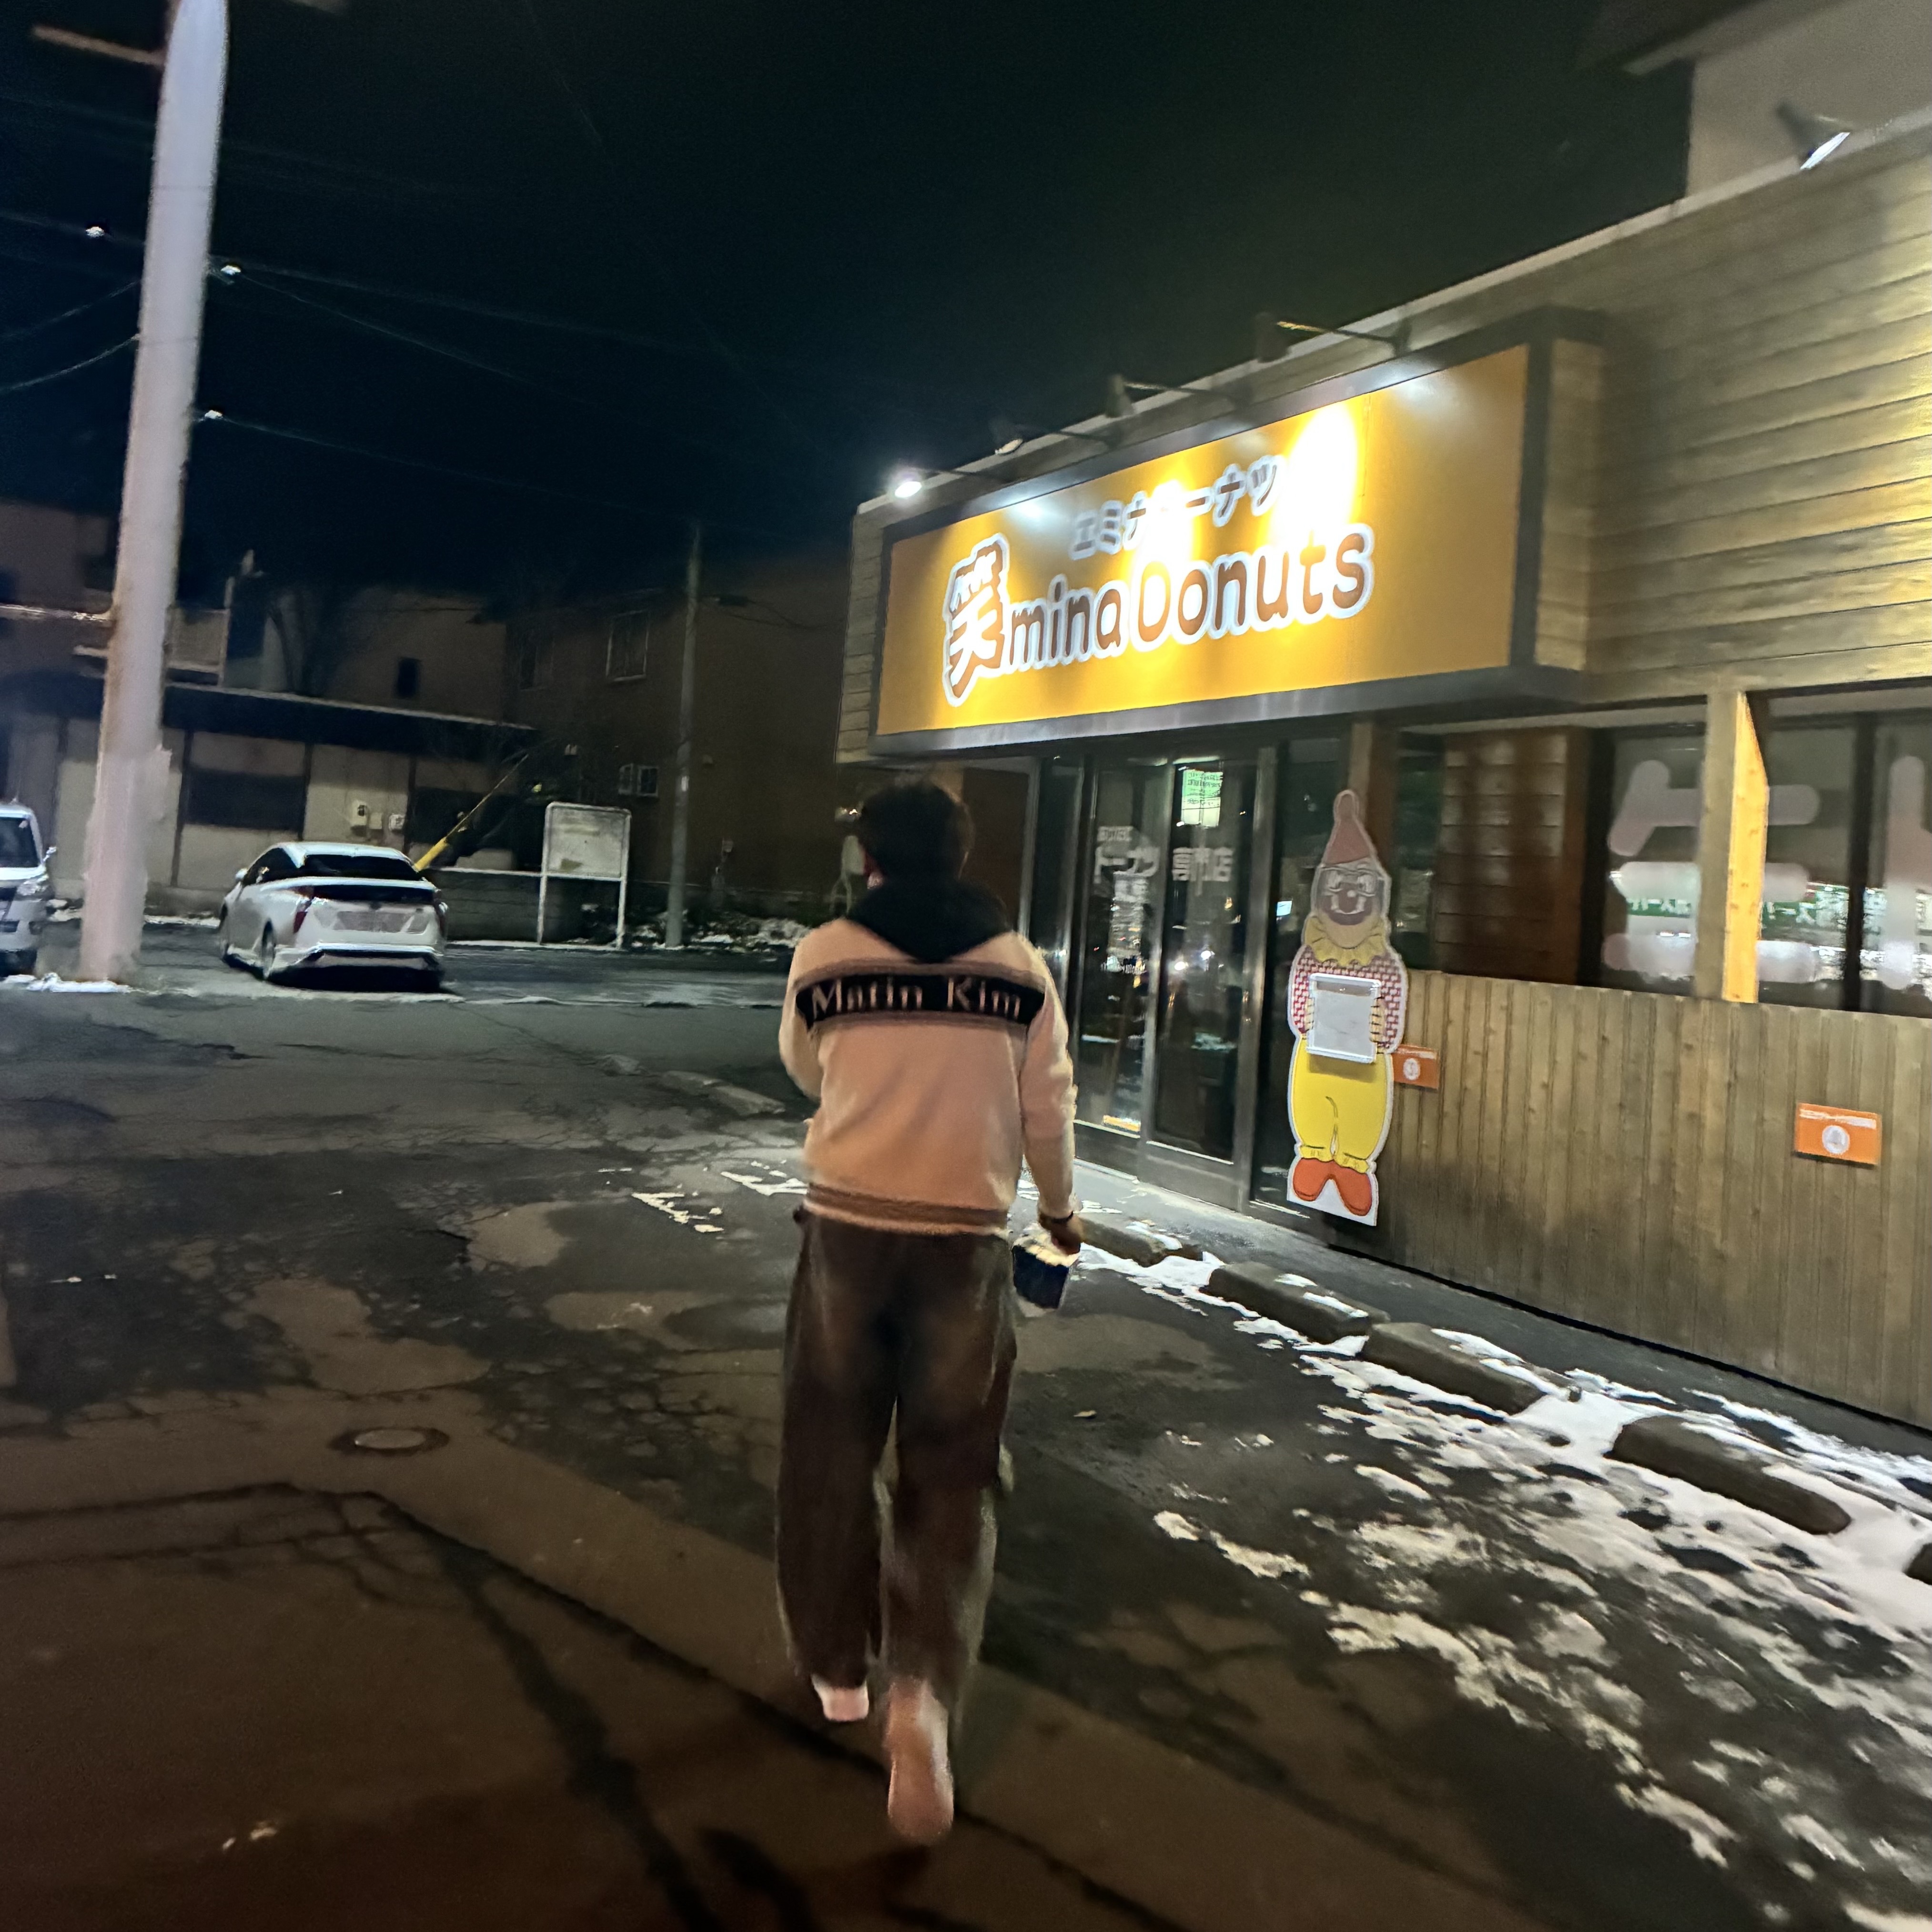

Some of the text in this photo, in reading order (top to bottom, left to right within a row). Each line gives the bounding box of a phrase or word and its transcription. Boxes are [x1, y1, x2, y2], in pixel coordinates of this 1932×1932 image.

[1073, 461, 1279, 553] エミナーナツ
[1138, 530, 1365, 643] Donuts
